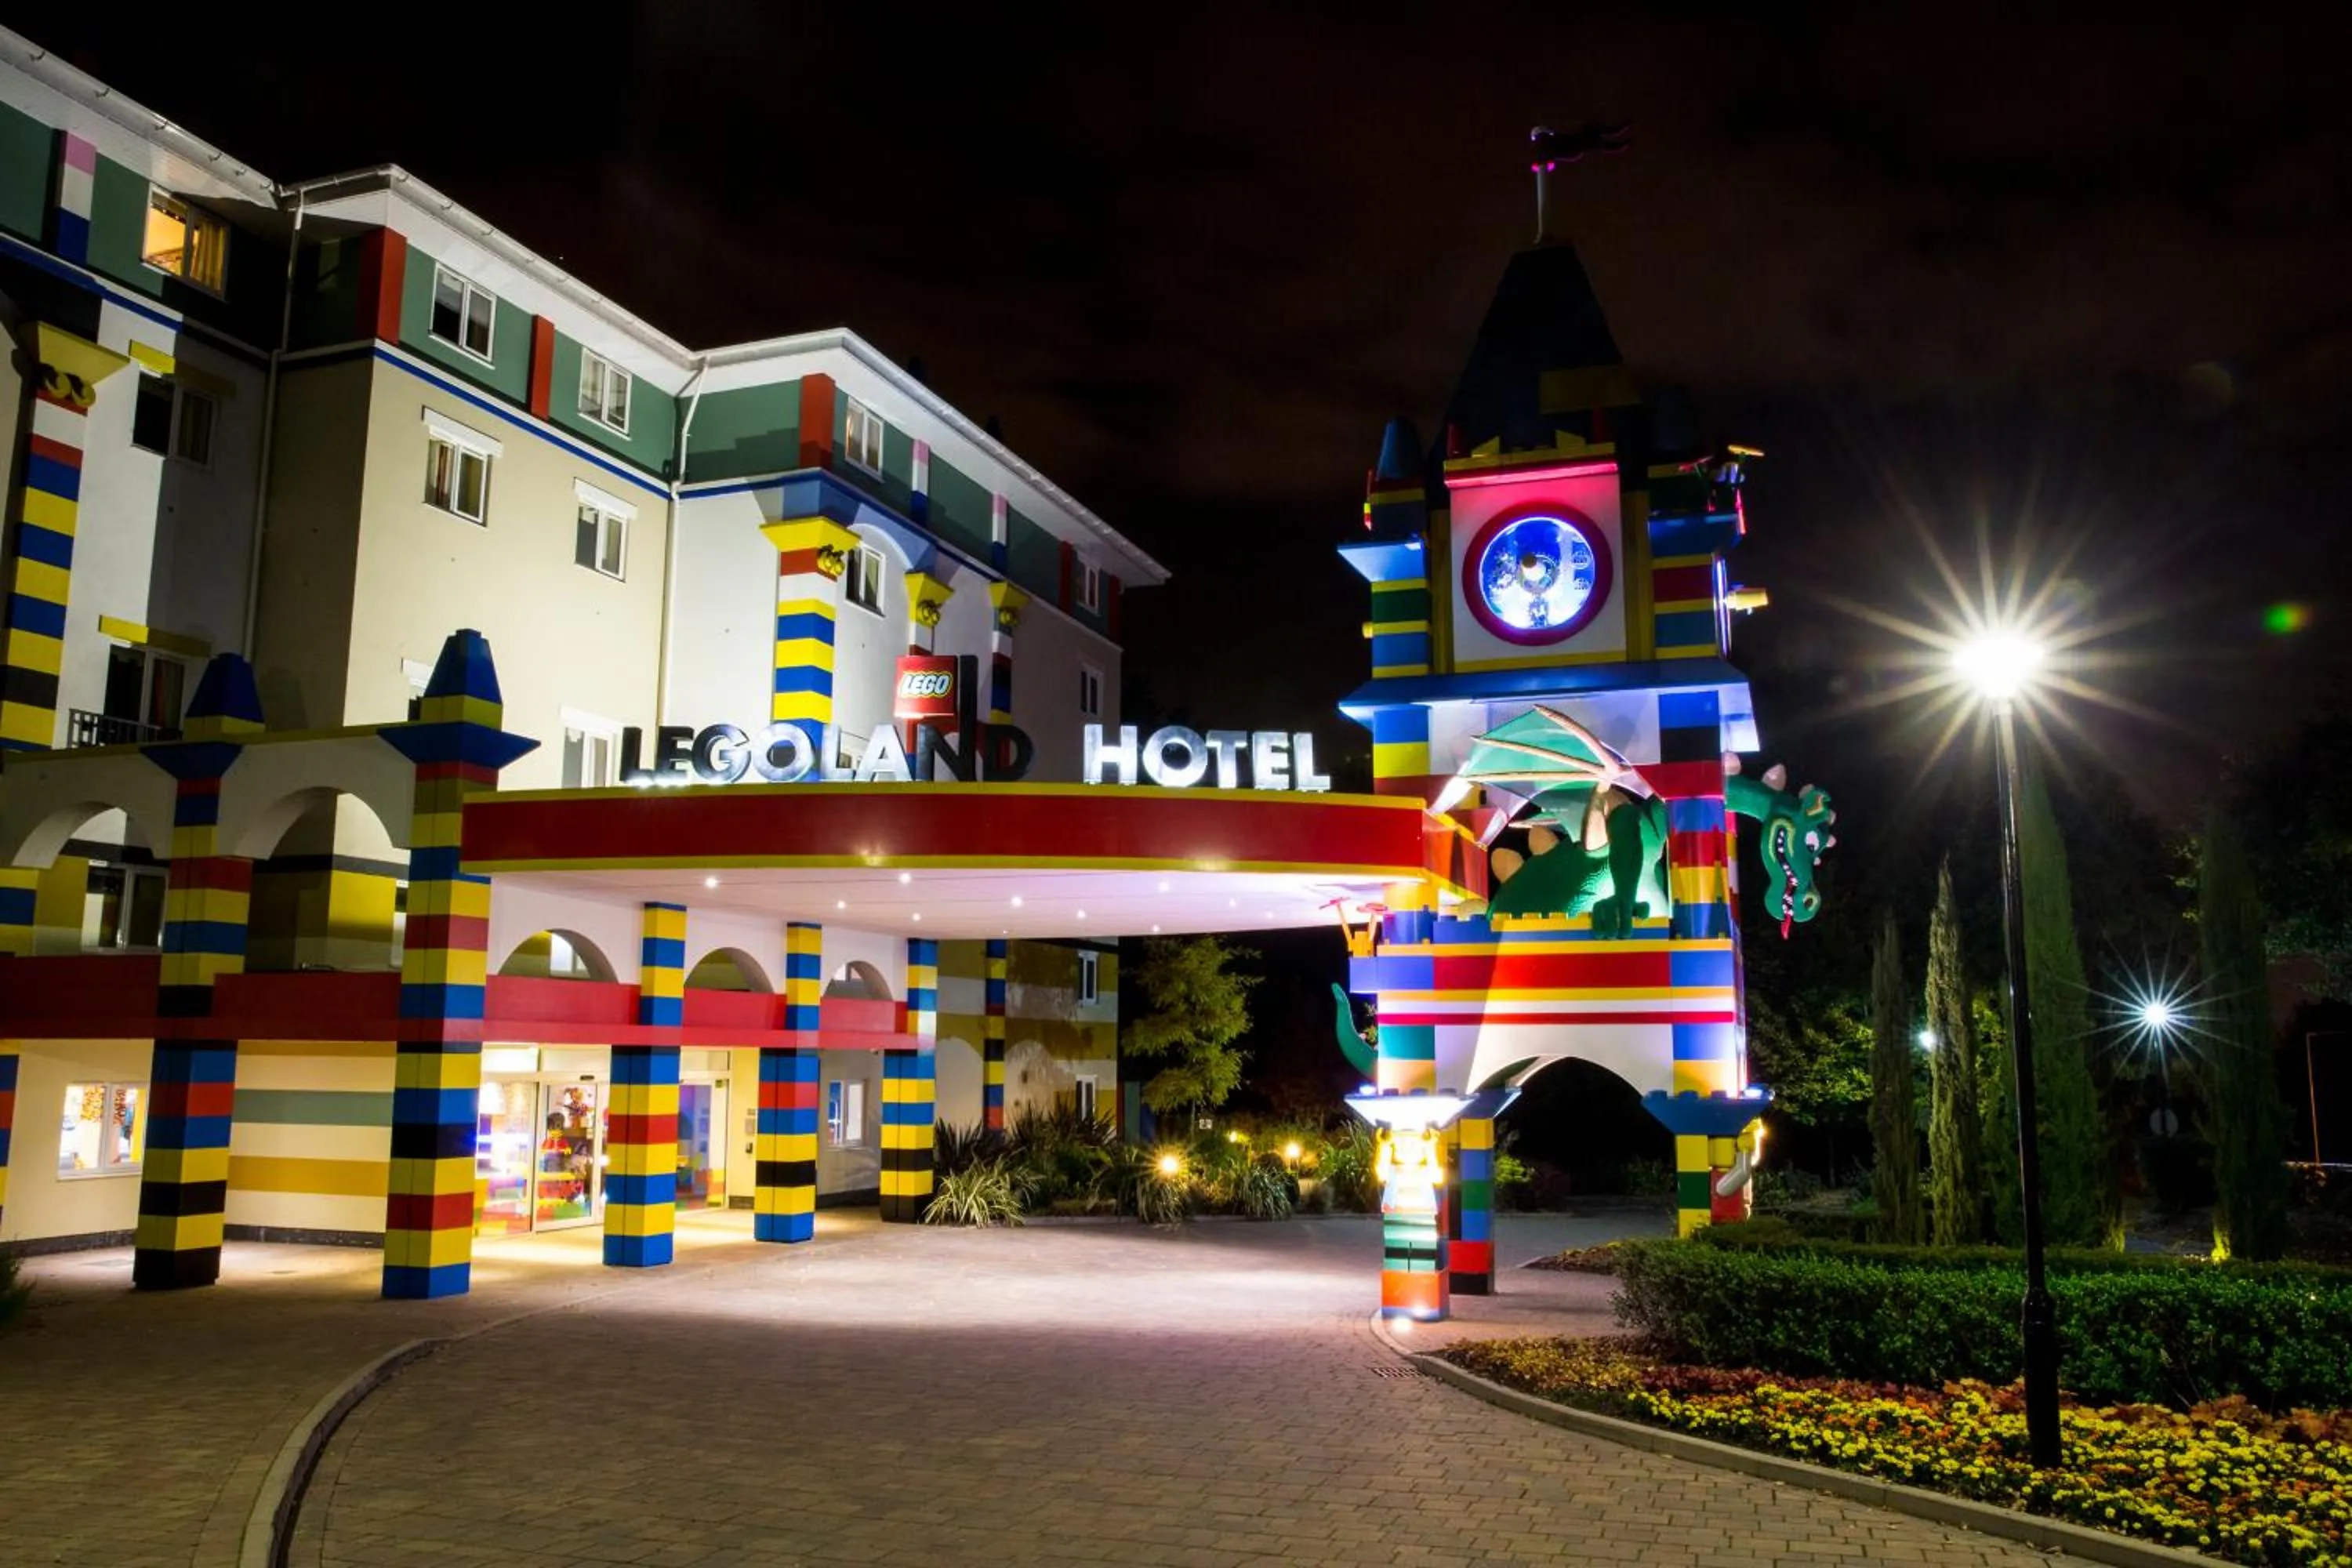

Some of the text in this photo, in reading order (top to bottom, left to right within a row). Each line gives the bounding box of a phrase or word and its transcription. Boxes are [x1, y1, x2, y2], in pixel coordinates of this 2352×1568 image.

[901, 673, 950, 695] LEGO
[619, 723, 1331, 791] LEGOLAND HOTEL
